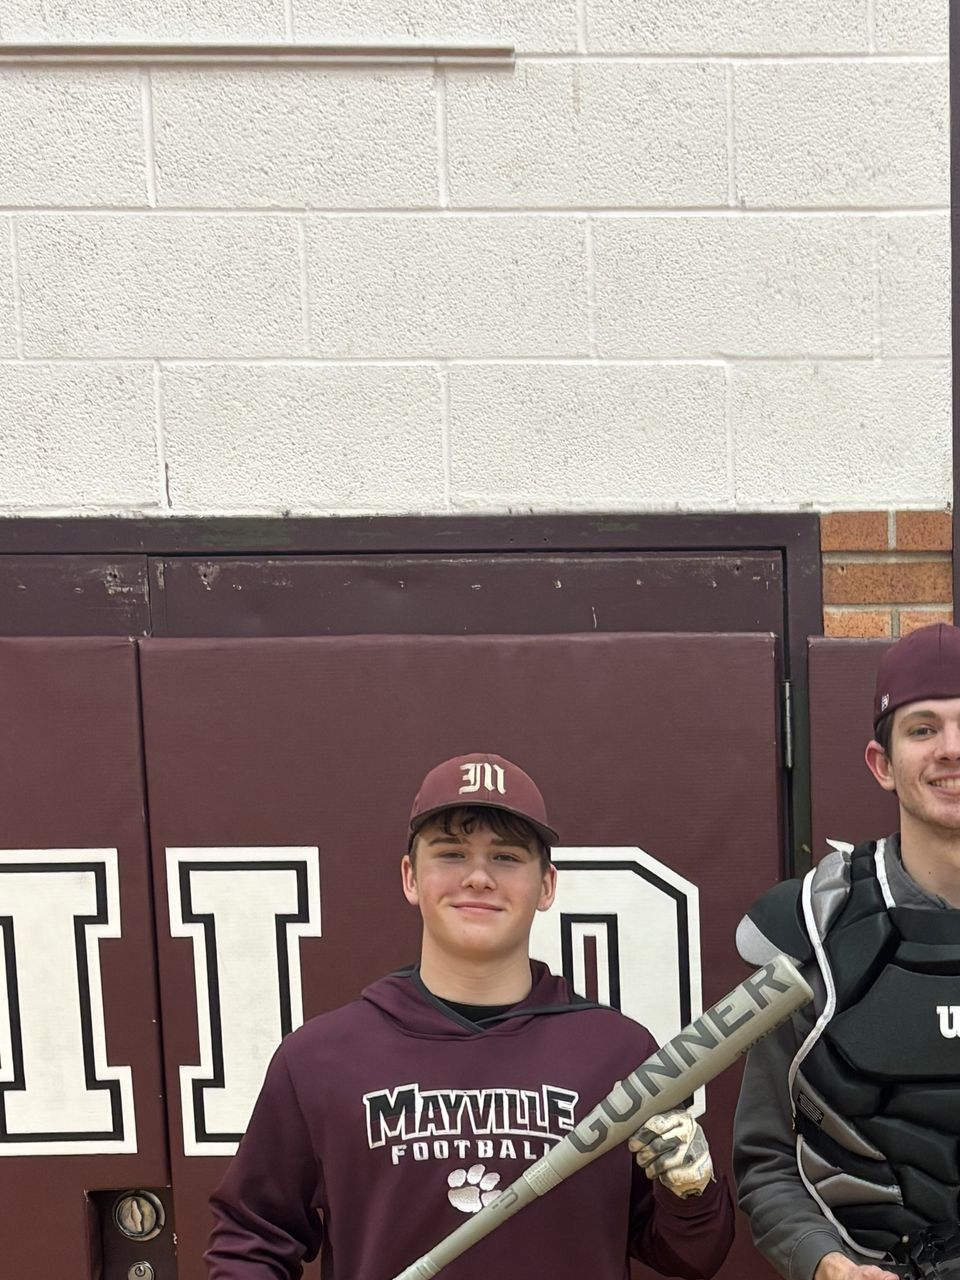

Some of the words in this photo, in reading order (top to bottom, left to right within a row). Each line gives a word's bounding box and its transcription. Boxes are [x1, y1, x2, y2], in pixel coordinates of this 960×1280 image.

[458, 762, 506, 795] M
[567, 963, 793, 1154] GUNNER
[363, 1083, 579, 1149] MAYVILLE
